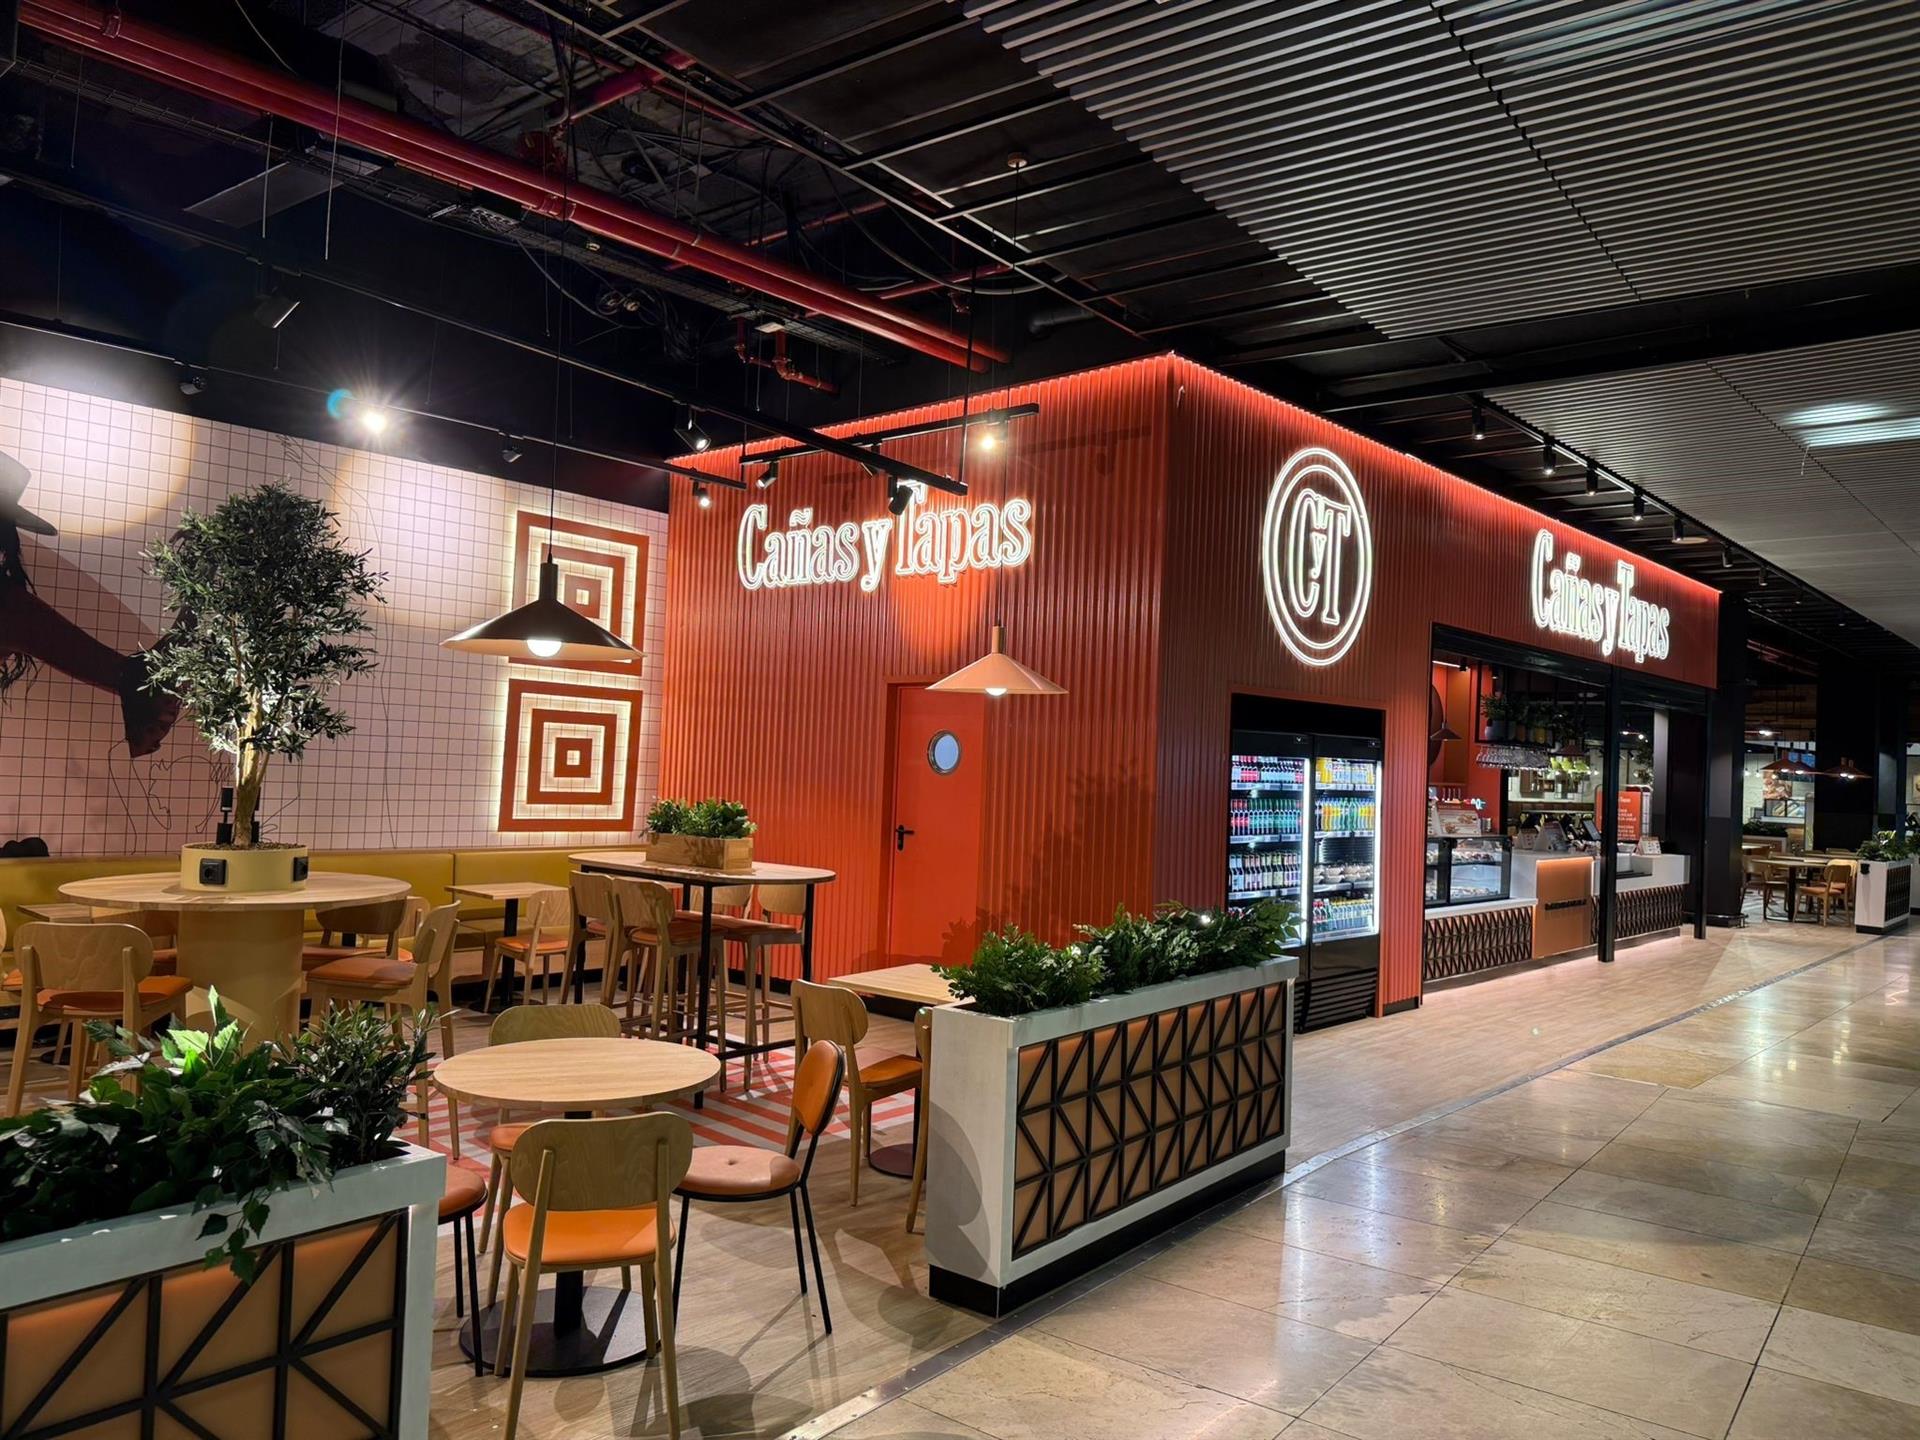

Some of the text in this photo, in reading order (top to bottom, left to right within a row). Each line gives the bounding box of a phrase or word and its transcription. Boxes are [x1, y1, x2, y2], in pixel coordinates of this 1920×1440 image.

[737, 479, 1032, 593] Cañas y Tapas
[1531, 528, 1671, 664] Cañas y Tapas
